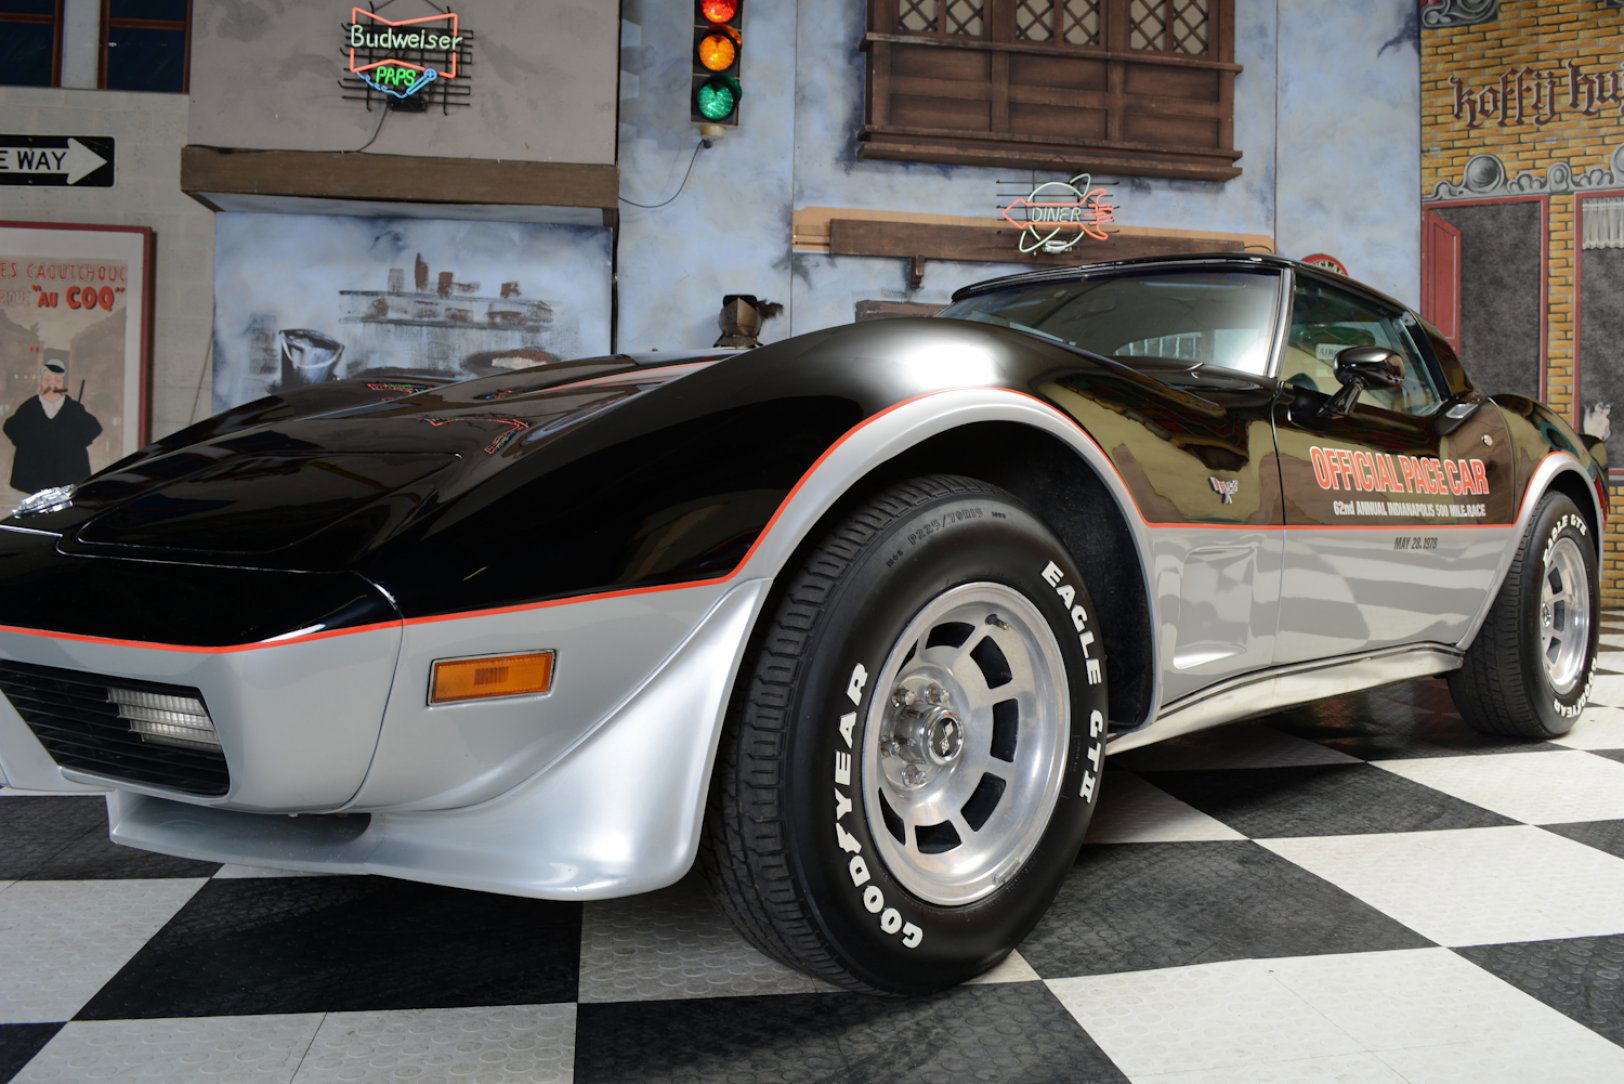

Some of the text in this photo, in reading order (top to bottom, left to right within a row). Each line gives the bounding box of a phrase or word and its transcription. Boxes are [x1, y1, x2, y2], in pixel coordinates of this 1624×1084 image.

[351, 24, 462, 50] Budweiser
[375, 66, 417, 87] PAPS
[17, 151, 67, 170] WAY
[1031, 206, 1082, 223] DINER
[1309, 446, 1490, 496] OFFICIAL PACE CAR
[1333, 501, 1356, 517] 62nd
[1356, 501, 1388, 516] ANNUAL
[1387, 502, 1435, 518] INDIANAPOLIS
[1435, 504, 1450, 518] 500
[1394, 537, 1411, 550] MAY
[1041, 560, 1102, 686] EAGLE
[834, 662, 924, 949] GOODYEAR
